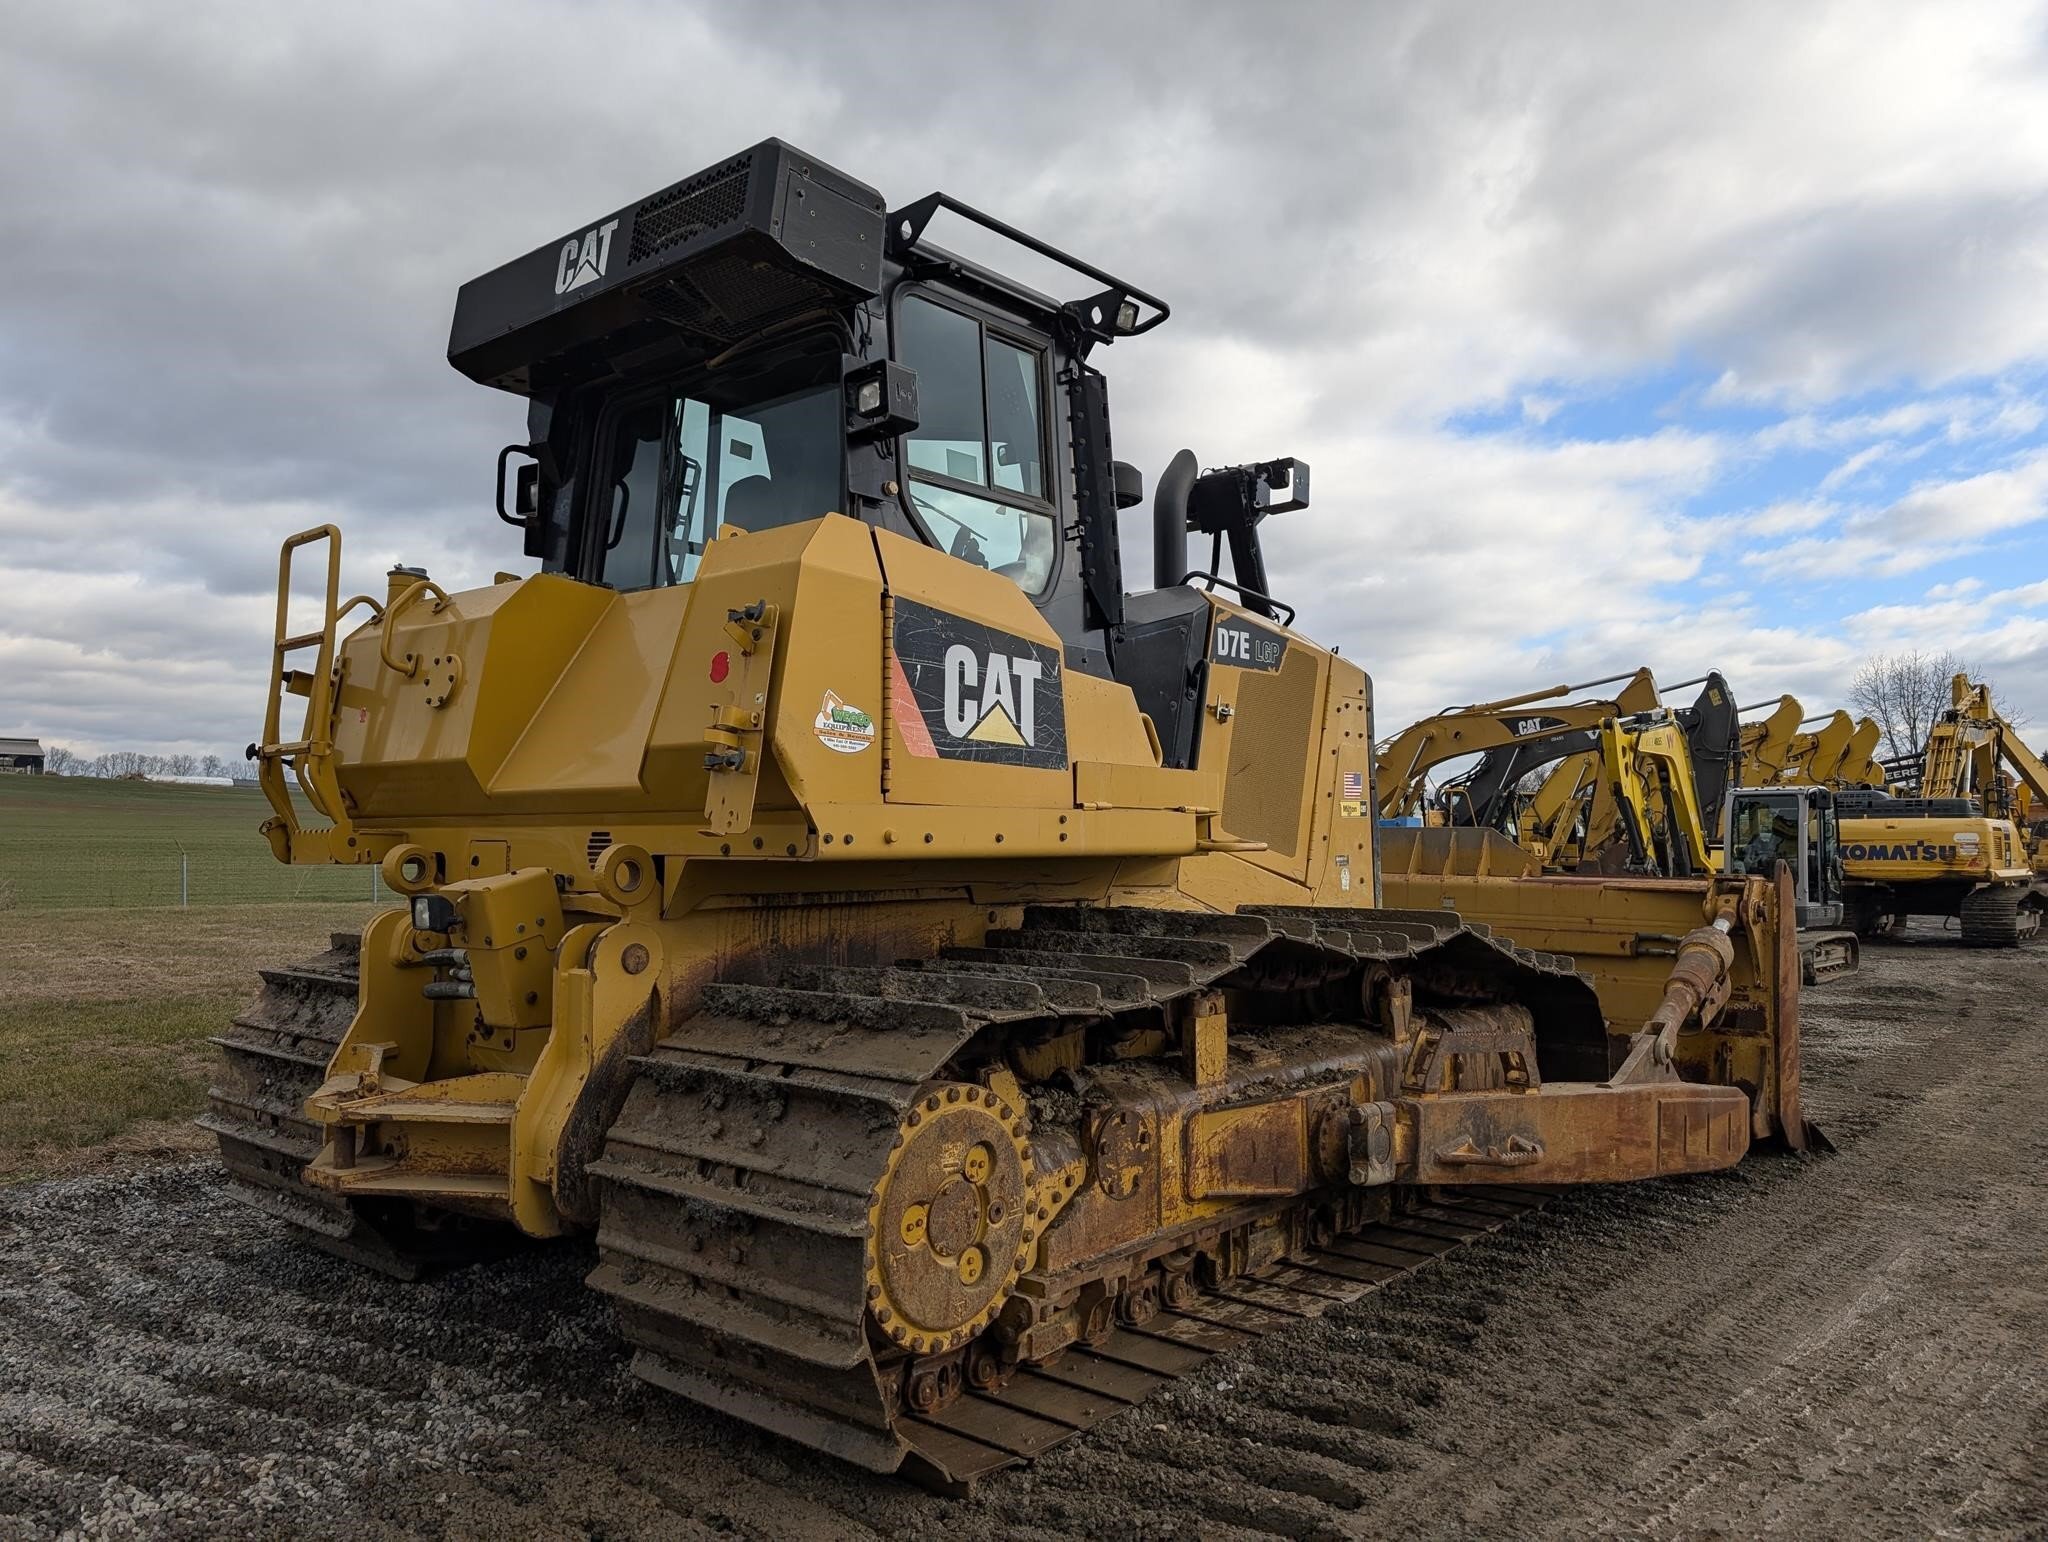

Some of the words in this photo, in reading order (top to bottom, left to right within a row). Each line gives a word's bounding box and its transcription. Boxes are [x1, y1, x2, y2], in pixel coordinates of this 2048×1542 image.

[555, 219, 619, 294] CAT
[1217, 627, 1250, 660] D7E
[1255, 640, 1280, 663] LGP
[944, 644, 1042, 747] CAT
[1518, 717, 1541, 735] CAT
[1885, 767, 1919, 780] EERE
